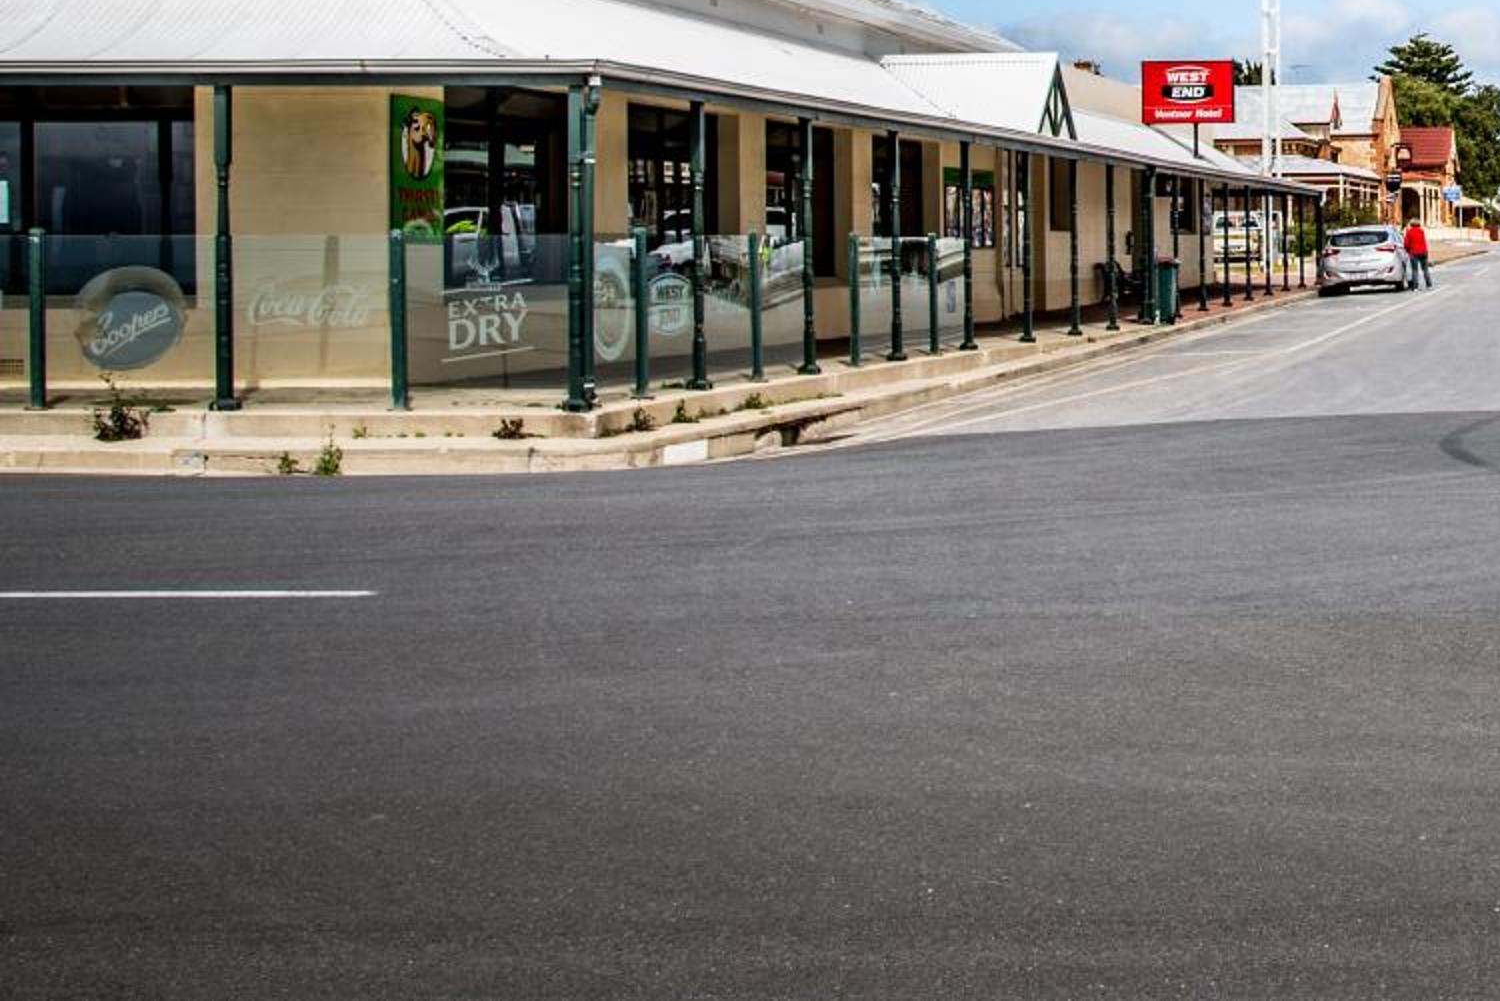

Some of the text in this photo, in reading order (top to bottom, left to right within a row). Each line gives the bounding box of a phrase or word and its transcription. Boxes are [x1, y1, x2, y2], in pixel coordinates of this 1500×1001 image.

[1166, 70, 1210, 83] WEST
[1171, 86, 1206, 98] END
[447, 291, 527, 318] EXTRA
[448, 308, 528, 350] DRY
